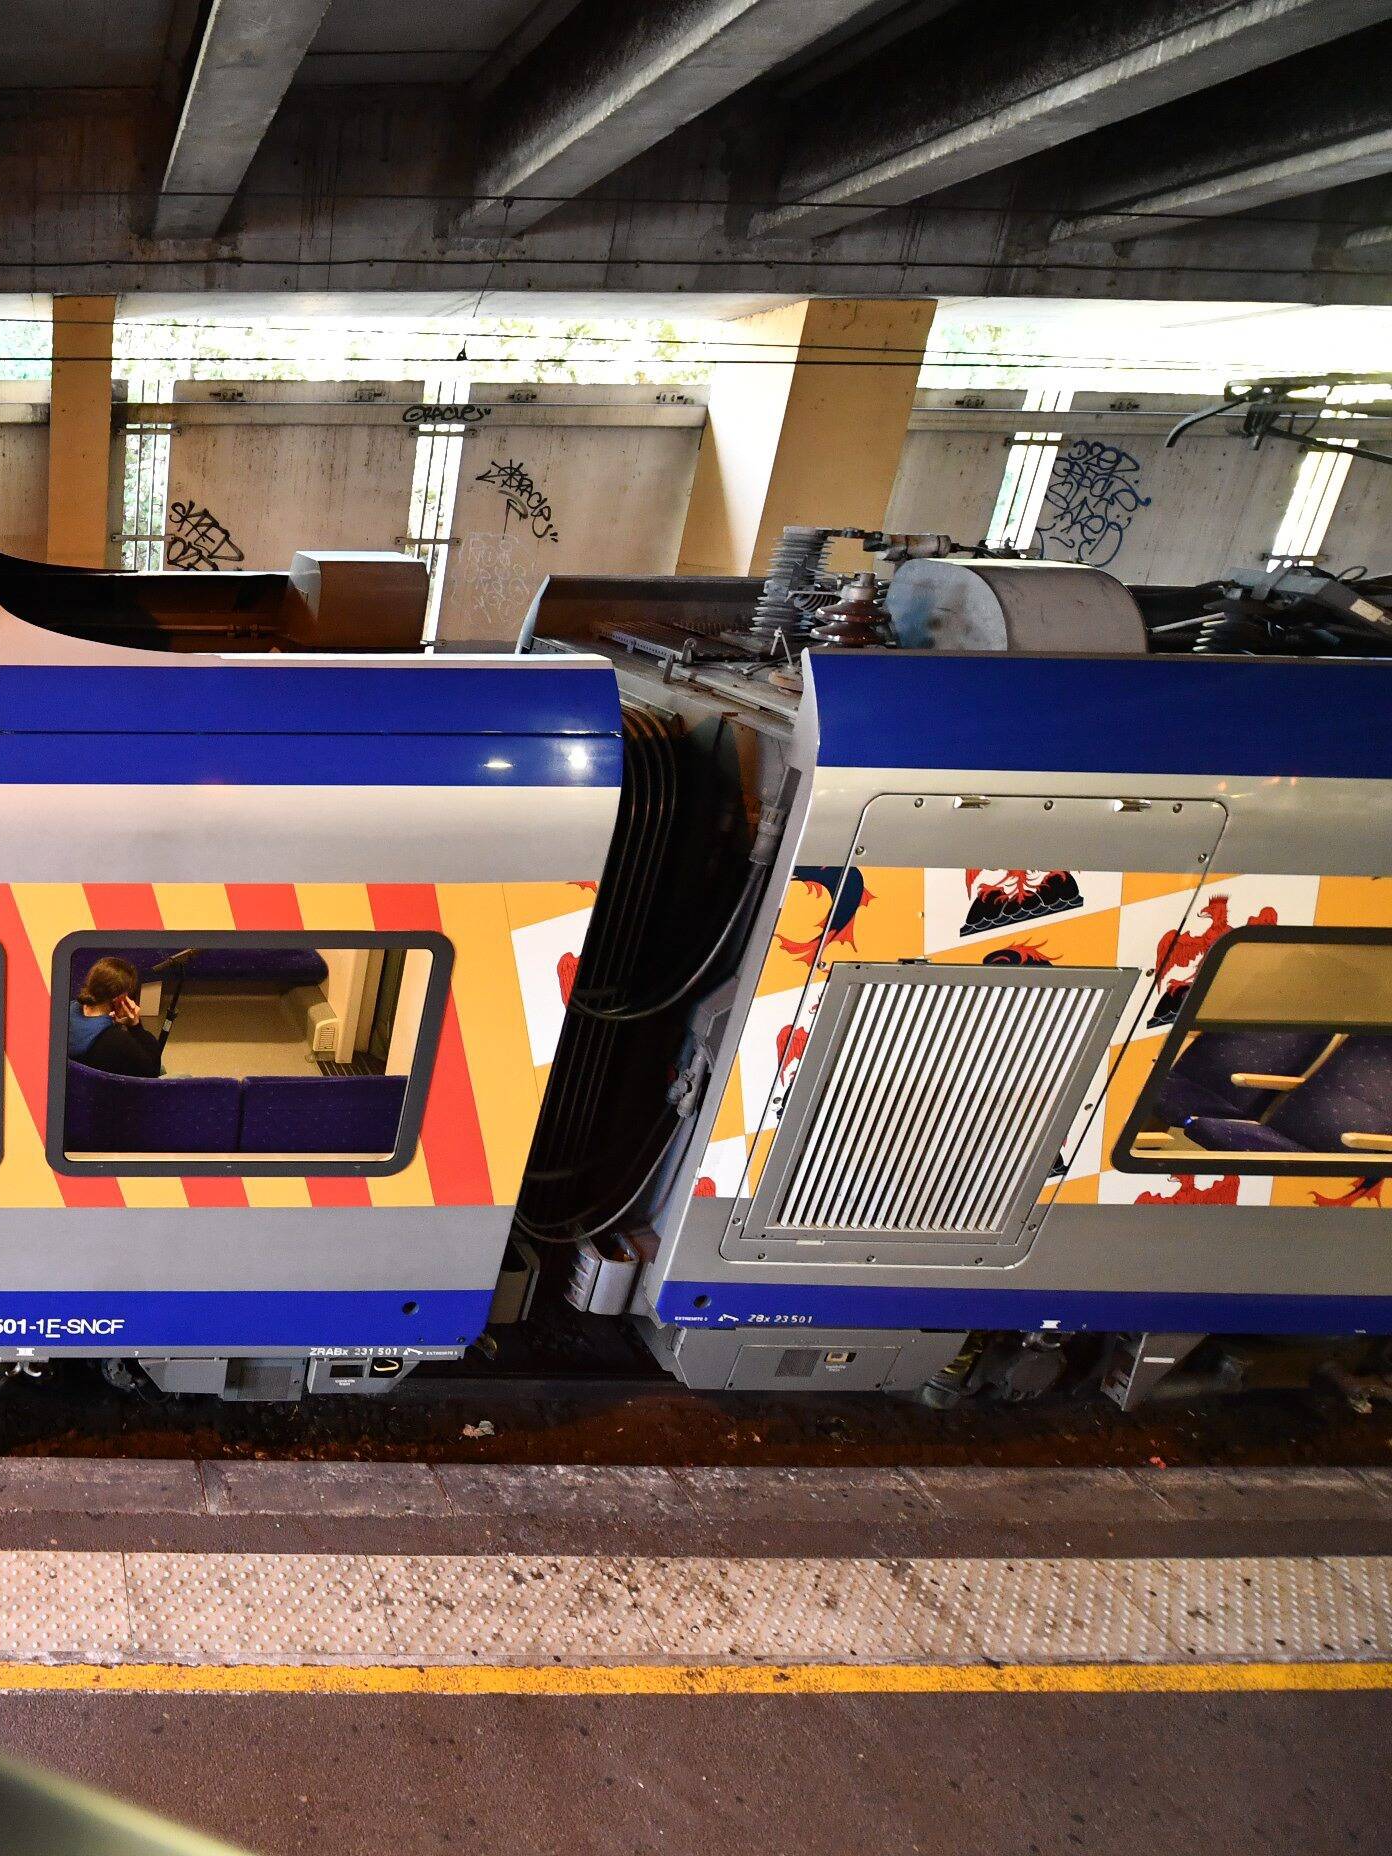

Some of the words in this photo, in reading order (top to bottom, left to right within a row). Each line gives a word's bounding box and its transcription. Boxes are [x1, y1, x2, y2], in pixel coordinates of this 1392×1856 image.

[309, 1347, 349, 1356] ZRABx
[354, 1347, 374, 1356] 231
[377, 1347, 398, 1356] 501
